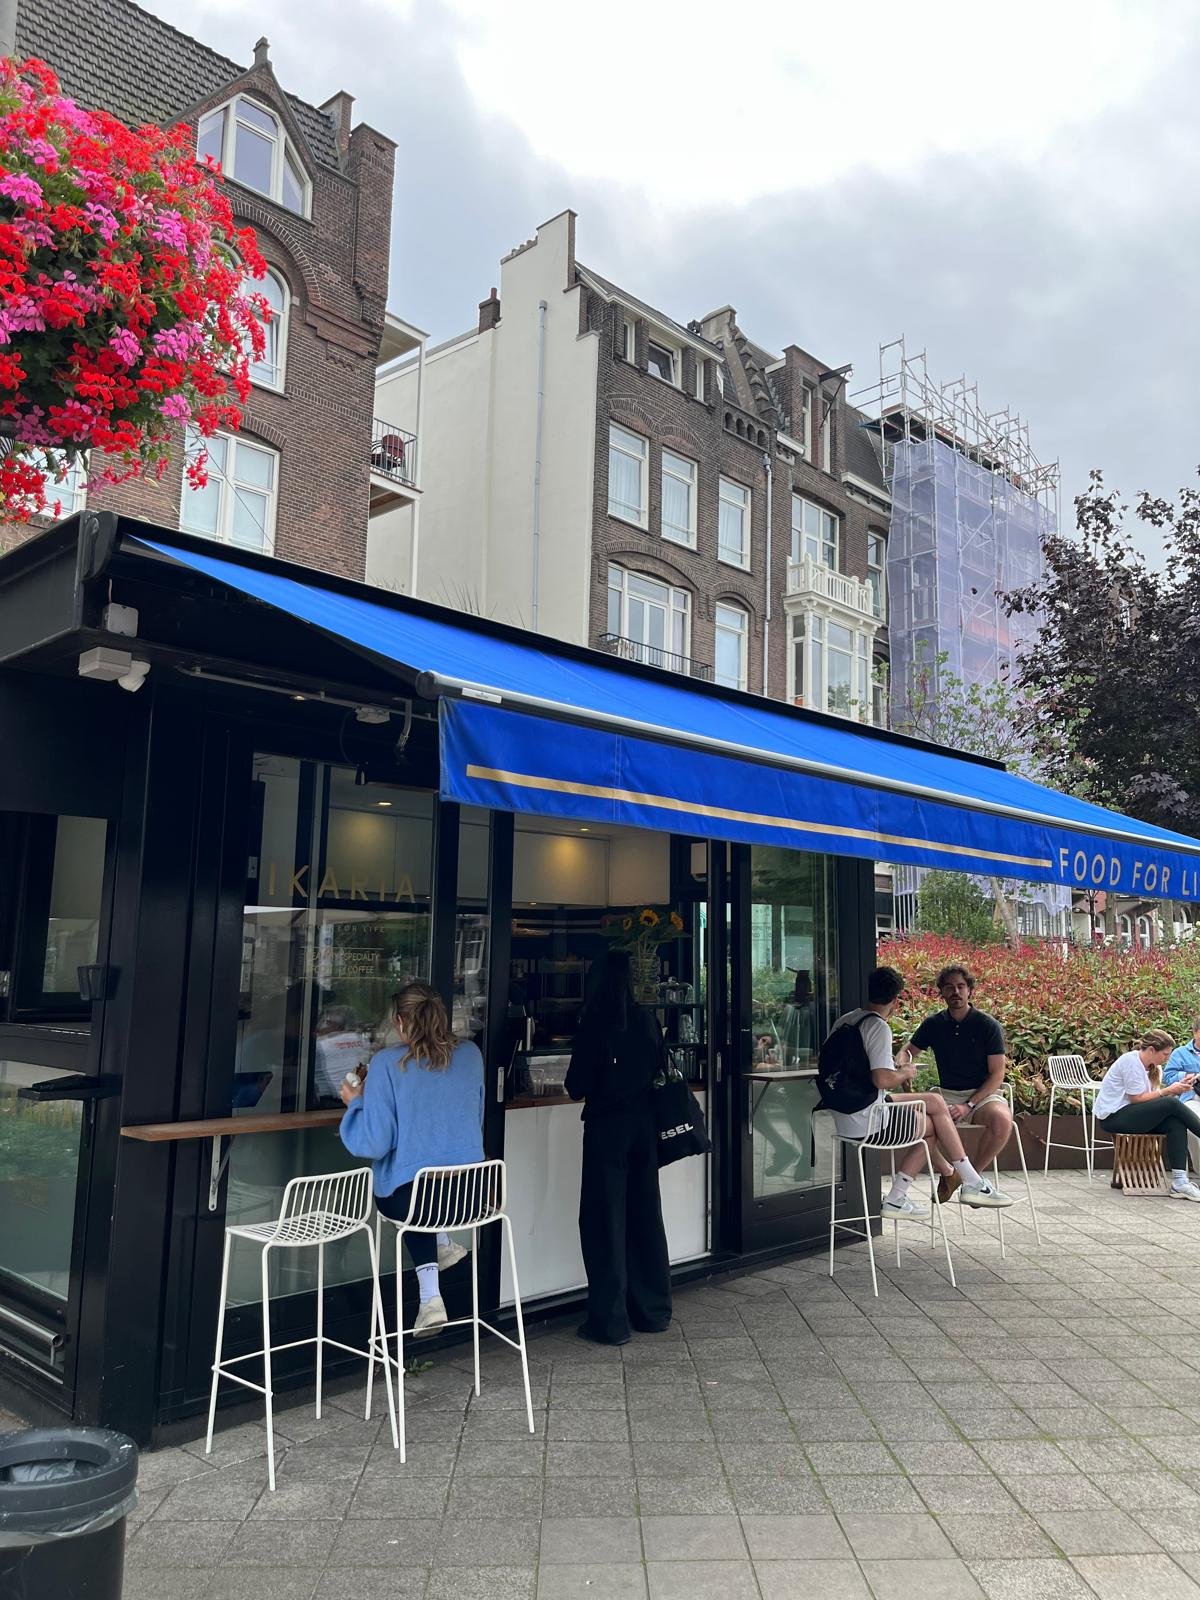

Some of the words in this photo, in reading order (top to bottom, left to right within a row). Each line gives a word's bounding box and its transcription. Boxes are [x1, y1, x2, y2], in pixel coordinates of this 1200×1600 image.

[269, 863, 416, 903] IKARIA
[1060, 848, 1121, 885] FOOD
[1132, 862, 1170, 893] FOR
[661, 1123, 694, 1140] ESEL
